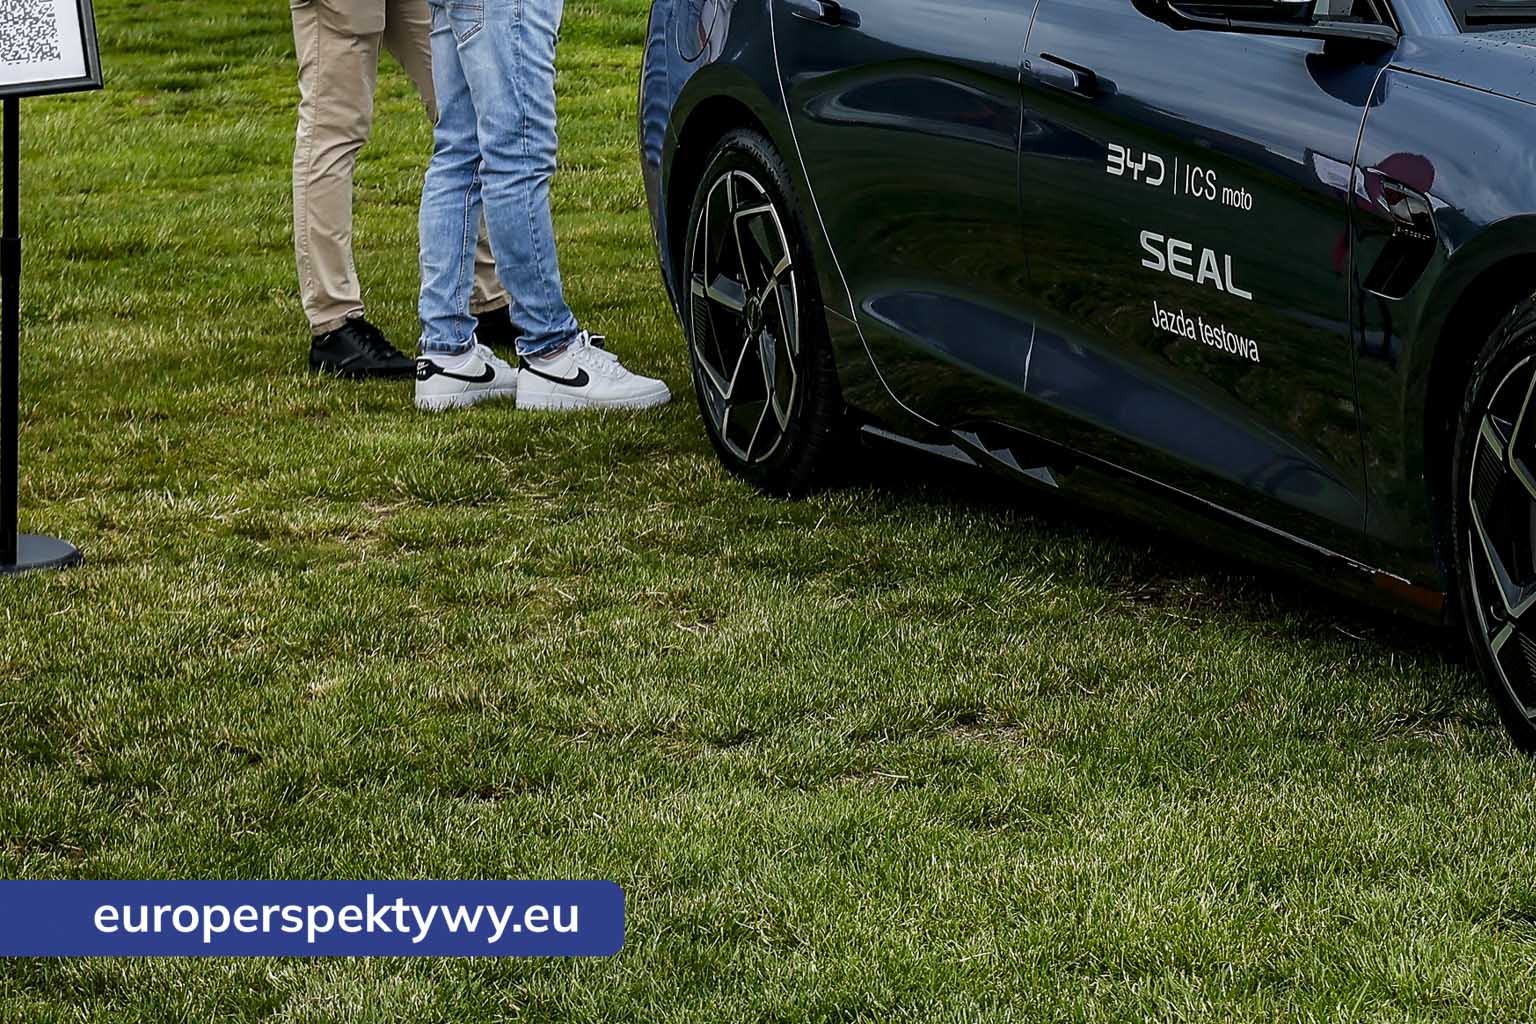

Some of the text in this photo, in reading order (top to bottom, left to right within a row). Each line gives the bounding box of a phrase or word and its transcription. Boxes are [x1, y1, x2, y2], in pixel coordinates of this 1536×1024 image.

[1106, 142, 1253, 211] BYD ICS moto
[1139, 229, 1253, 301] SEAL
[1151, 300, 1261, 363] Jazda testowa
